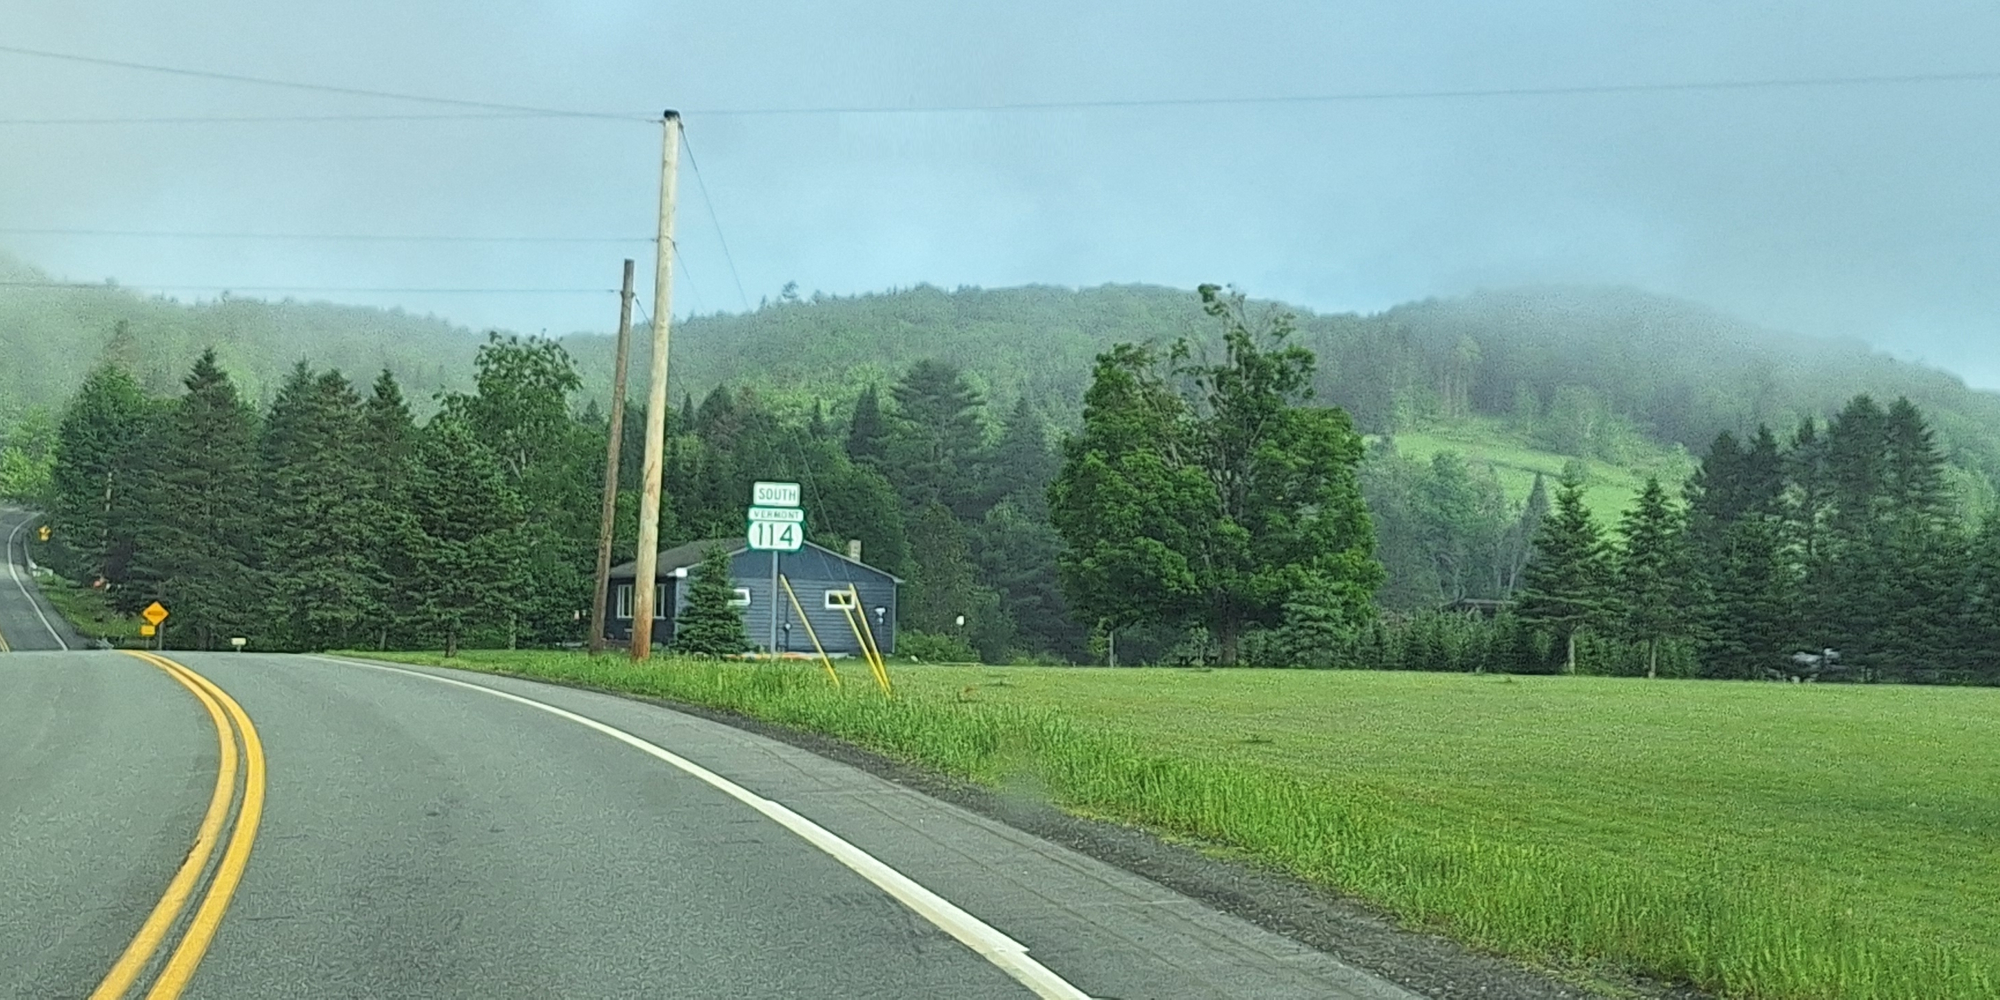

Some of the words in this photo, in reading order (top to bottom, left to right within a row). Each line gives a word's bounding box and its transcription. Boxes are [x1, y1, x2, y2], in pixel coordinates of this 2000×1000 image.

[758, 488, 796, 501] SOUTH
[754, 510, 799, 519] VERMONT
[758, 523, 794, 547] 114
